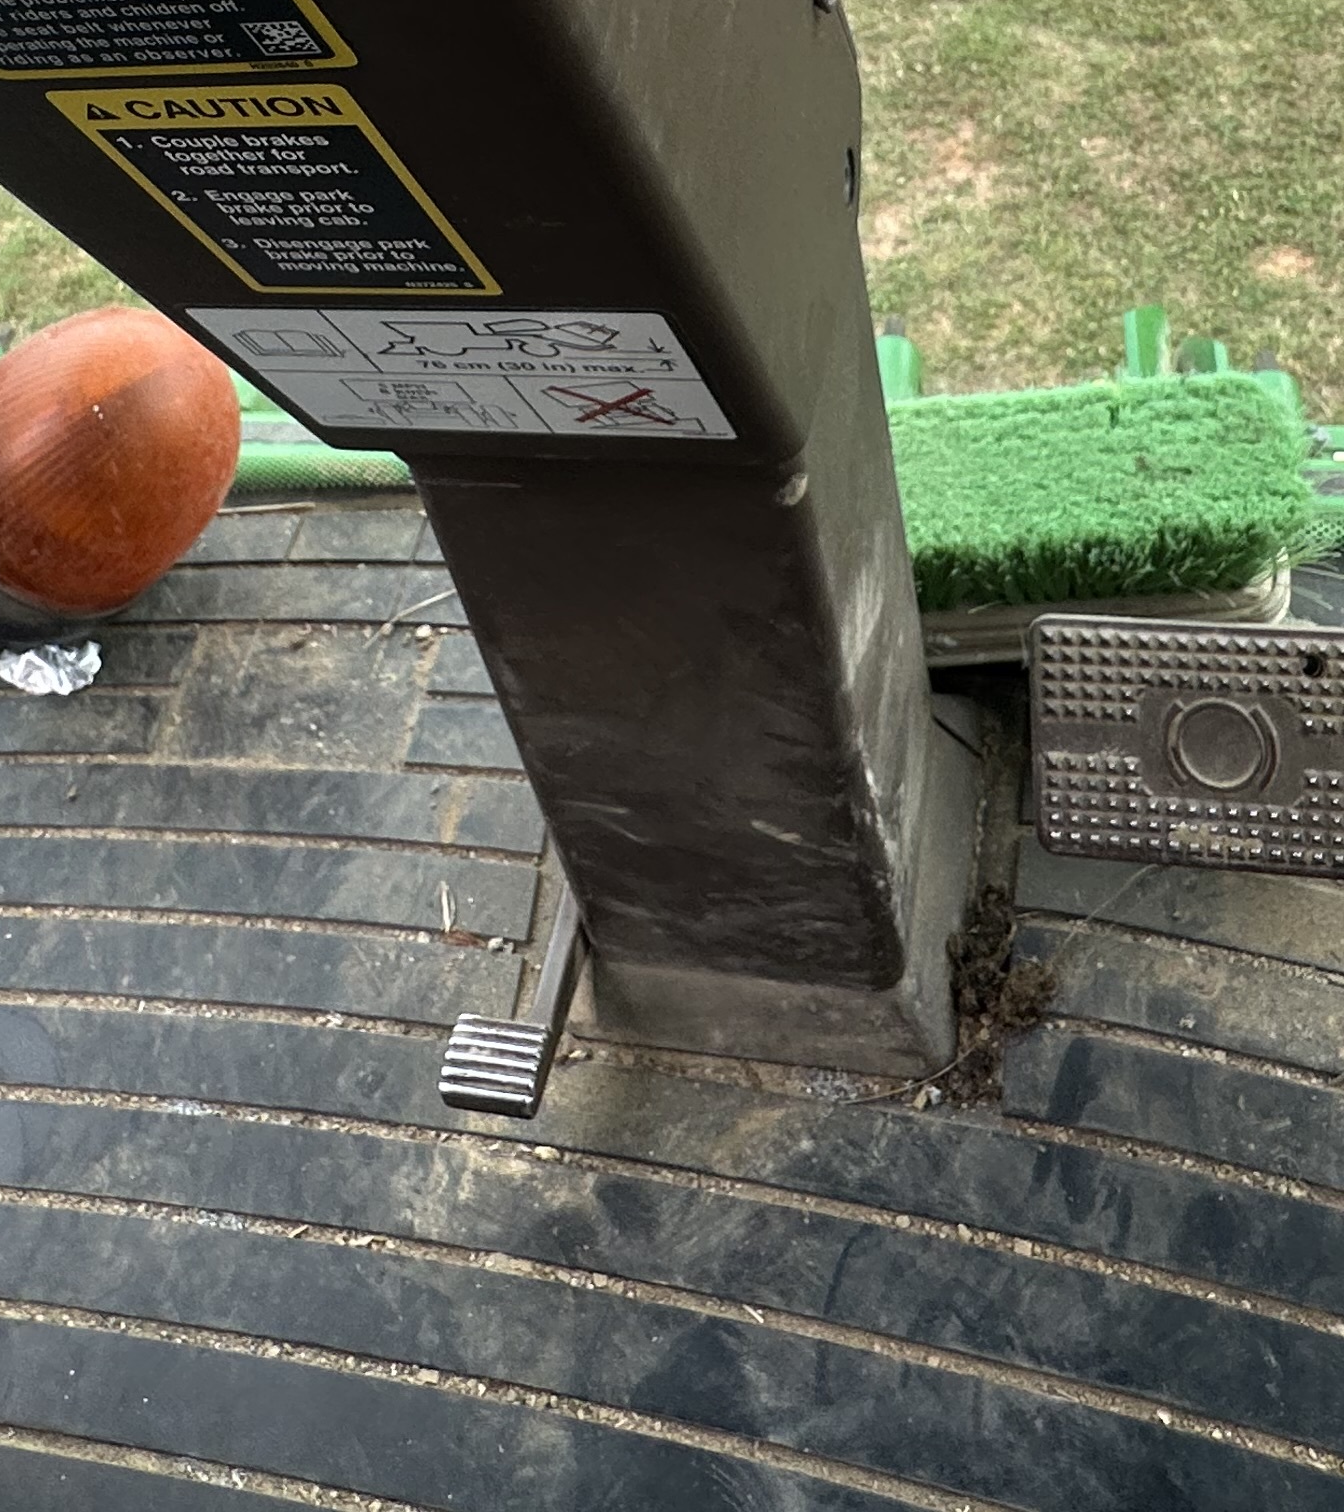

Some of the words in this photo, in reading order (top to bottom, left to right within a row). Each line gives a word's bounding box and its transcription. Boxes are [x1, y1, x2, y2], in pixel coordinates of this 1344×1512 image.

[8, 8, 74, 23] riders
[76, 5, 119, 19] and
[119, 0, 207, 17] children
[209, 0, 246, 13] off.
[11, 23, 58, 36] seat
[60, 21, 105, 35] belt
[108, 19, 212, 33] whenever
[76, 37, 110, 49] the
[114, 33, 199, 48] machine
[202, 32, 226, 44] or
[67, 52, 94, 63] as
[99, 51, 129, 63] an
[133, 47, 242, 61] observer.
[125, 96, 343, 119] CAUTION
[116, 136, 144, 149] 1.
[150, 134, 240, 150] Couple
[241, 133, 330, 147] brakes
[164, 148, 266, 165] together
[270, 148, 307, 161] for
[179, 162, 236, 176] road
[237, 161, 360, 177] transport.
[170, 189, 199, 202] 2.
[204, 189, 294, 204] Engage
[298, 188, 356, 202] park
[216, 202, 284, 215] brake
[288, 202, 346, 216] prior
[348, 202, 375, 214] to
[228, 214, 315, 228] leaving
[317, 214, 369, 226] cab.
[220, 238, 246, 249] 3.
[253, 238, 373, 252] Disengage
[377, 238, 431, 251] park
[264, 249, 328, 261] brake
[332, 249, 386, 262] prior
[390, 249, 416, 260] to
[277, 261, 360, 273] moving
[362, 260, 466, 273] machine.
[416, 359, 447, 371] 76
[453, 361, 494, 372] cm
[496, 359, 536, 373] (30
[540, 360, 577, 374] in)
[582, 364, 647, 375] max.
